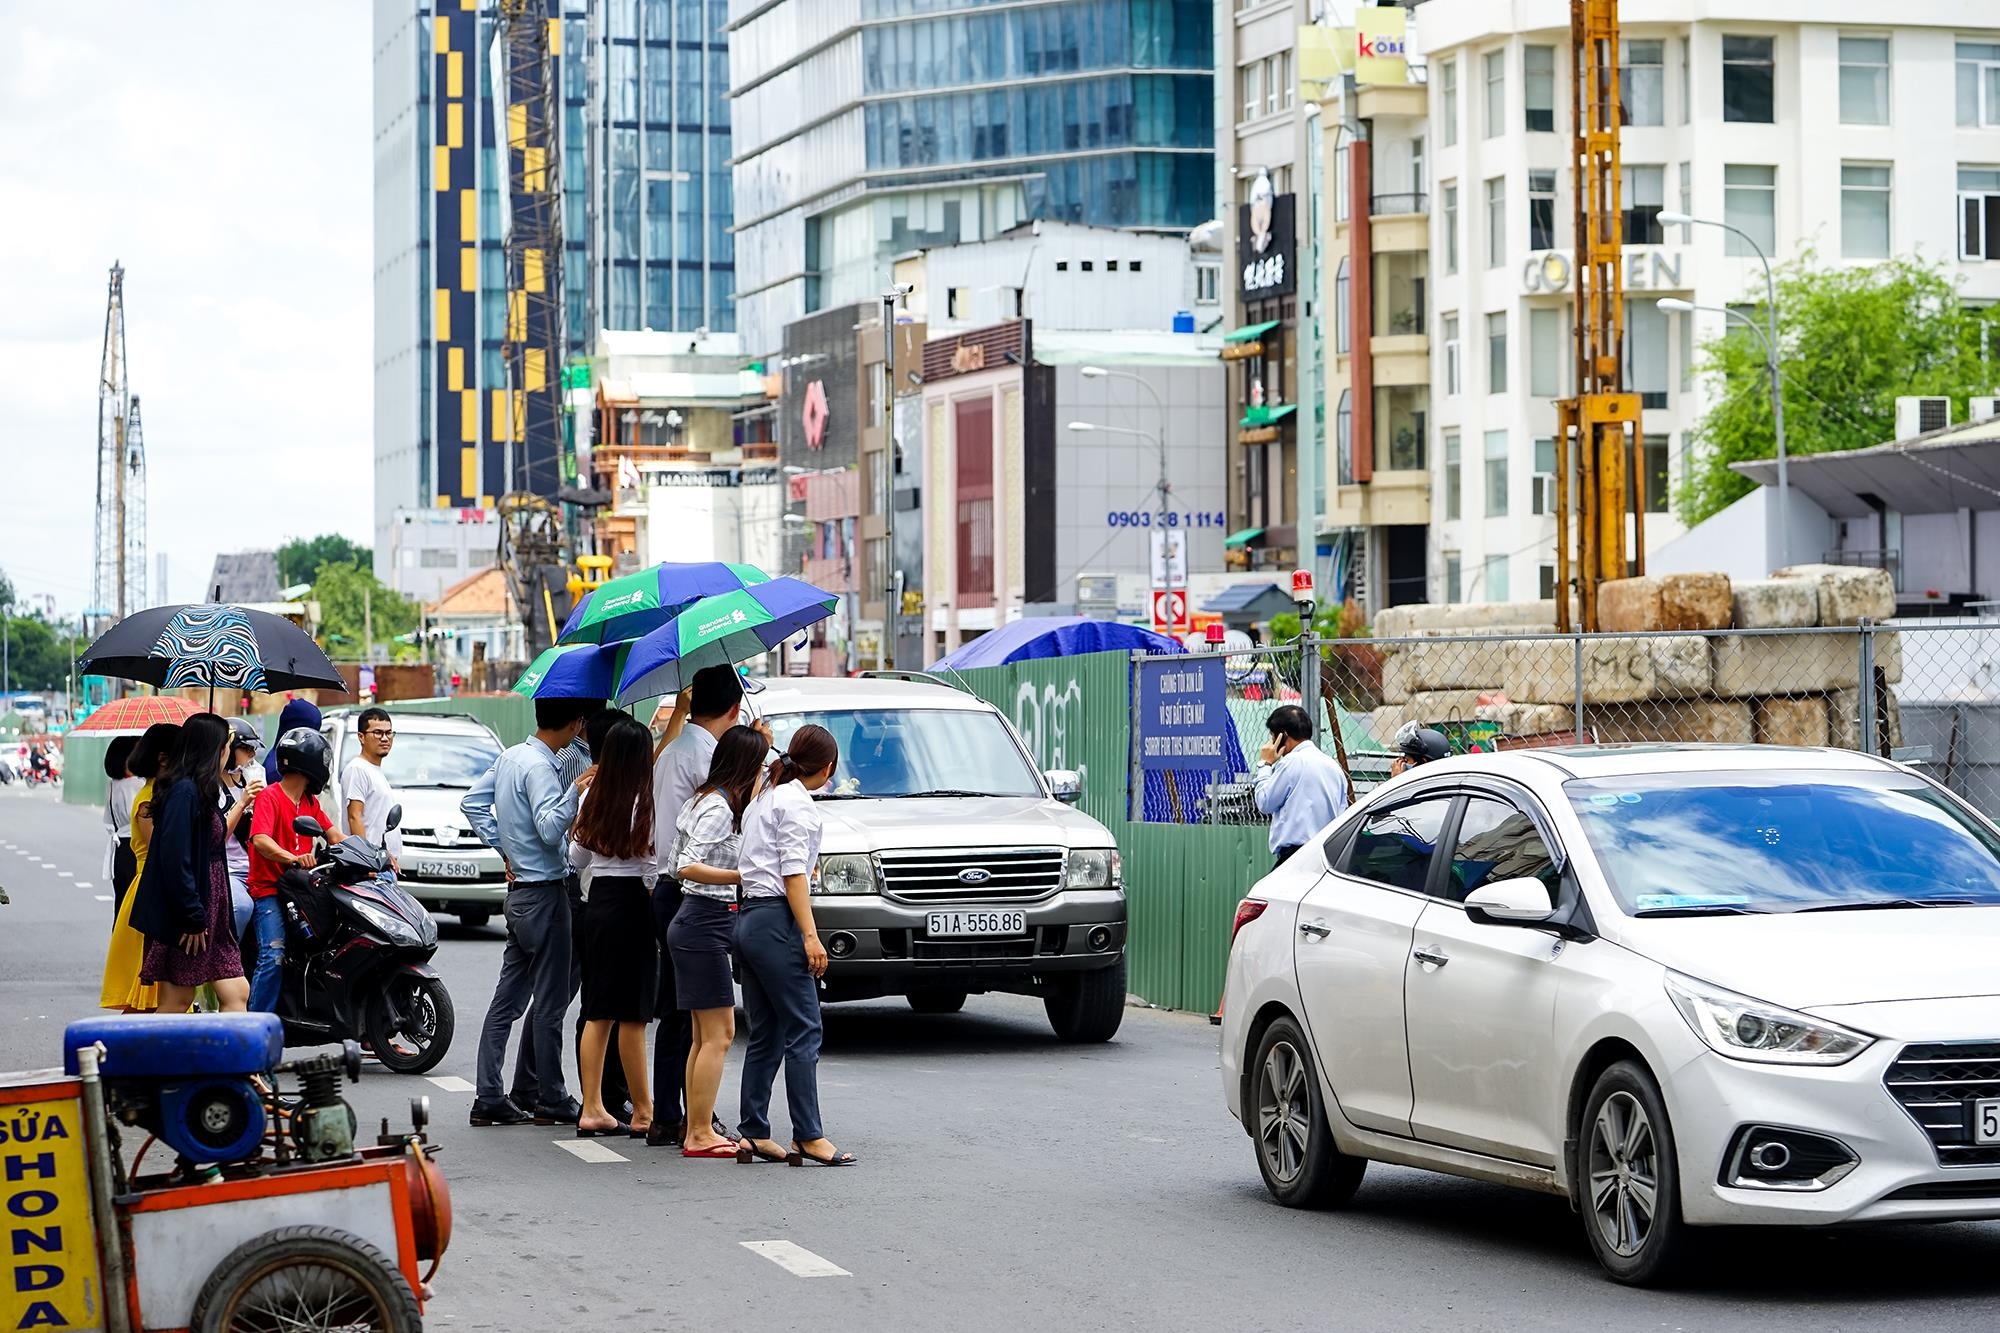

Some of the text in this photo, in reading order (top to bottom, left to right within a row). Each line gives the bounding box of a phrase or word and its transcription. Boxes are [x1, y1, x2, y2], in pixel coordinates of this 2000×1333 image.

[1524, 252, 1681, 291] GOEN
[1108, 512, 1150, 527] 0903
[698, 615, 730, 630] Standard
[698, 620, 732, 636] Chartered
[1145, 737, 1159, 756] SORRY
[1160, 736, 1171, 756] FOR
[1171, 736, 1182, 756] THIS
[966, 871, 983, 880] Ford
[4, 1152, 70, 1330] HONDA
